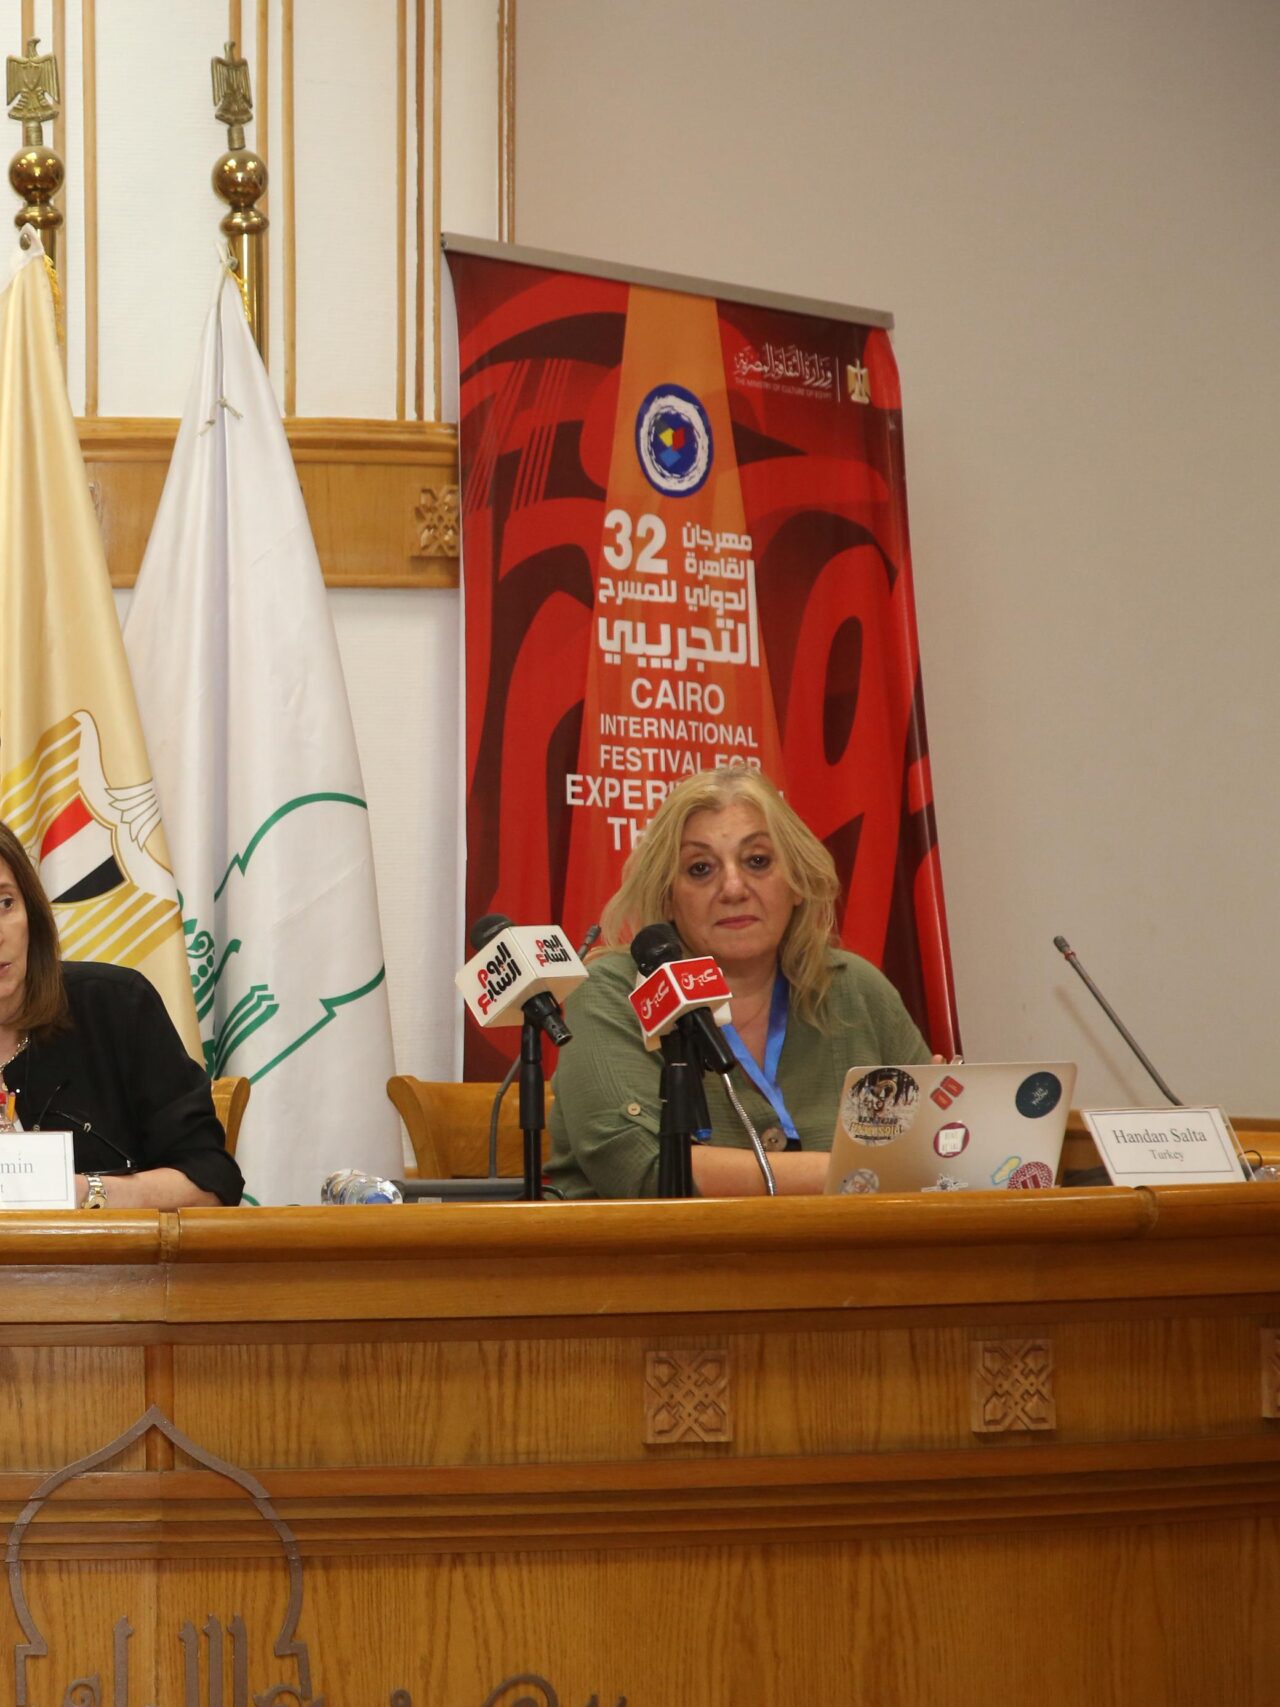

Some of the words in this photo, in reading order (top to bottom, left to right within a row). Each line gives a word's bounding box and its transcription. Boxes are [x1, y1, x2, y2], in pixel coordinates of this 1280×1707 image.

[603, 508, 669, 574] 32
[682, 521, 753, 554] مهرجان
[598, 577, 678, 606] للمسرح
[598, 616, 760, 673] التجريبي
[630, 677, 726, 716] CAIRO
[600, 713, 759, 748] INTERNATIONAL
[477, 941, 512, 989] اليوم
[477, 958, 522, 1015] السابع
[1111, 1129, 1169, 1144] Handan
[1170, 1128, 1208, 1143] Salta
[1149, 1149, 1185, 1162] Turkey
